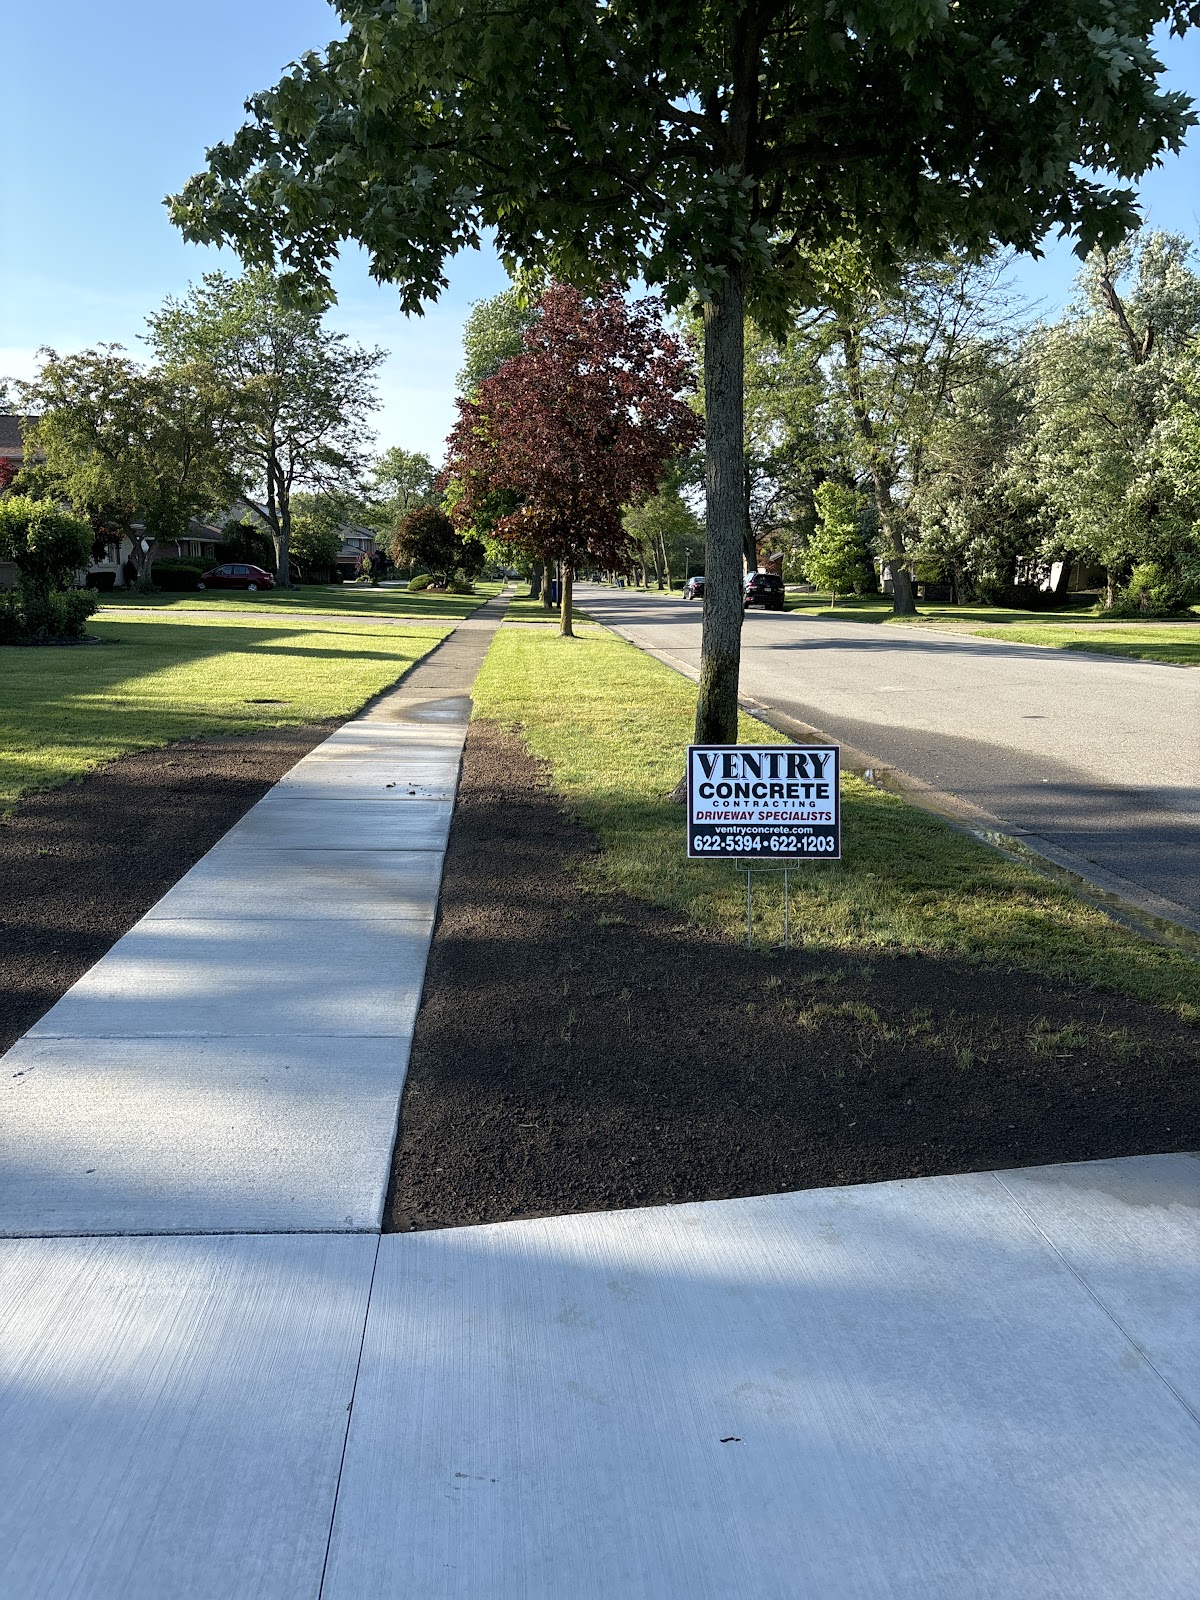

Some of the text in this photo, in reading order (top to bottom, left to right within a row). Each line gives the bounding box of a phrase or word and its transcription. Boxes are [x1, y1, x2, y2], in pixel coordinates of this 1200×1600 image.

[697, 753, 831, 780] VENTRY
[699, 783, 829, 799] CONCRETE
[696, 811, 832, 821] DRIVEWAY SPECIALISTS
[715, 826, 813, 835] ventryconcrete.com
[694, 835, 834, 851] 622-5394 622-1203
